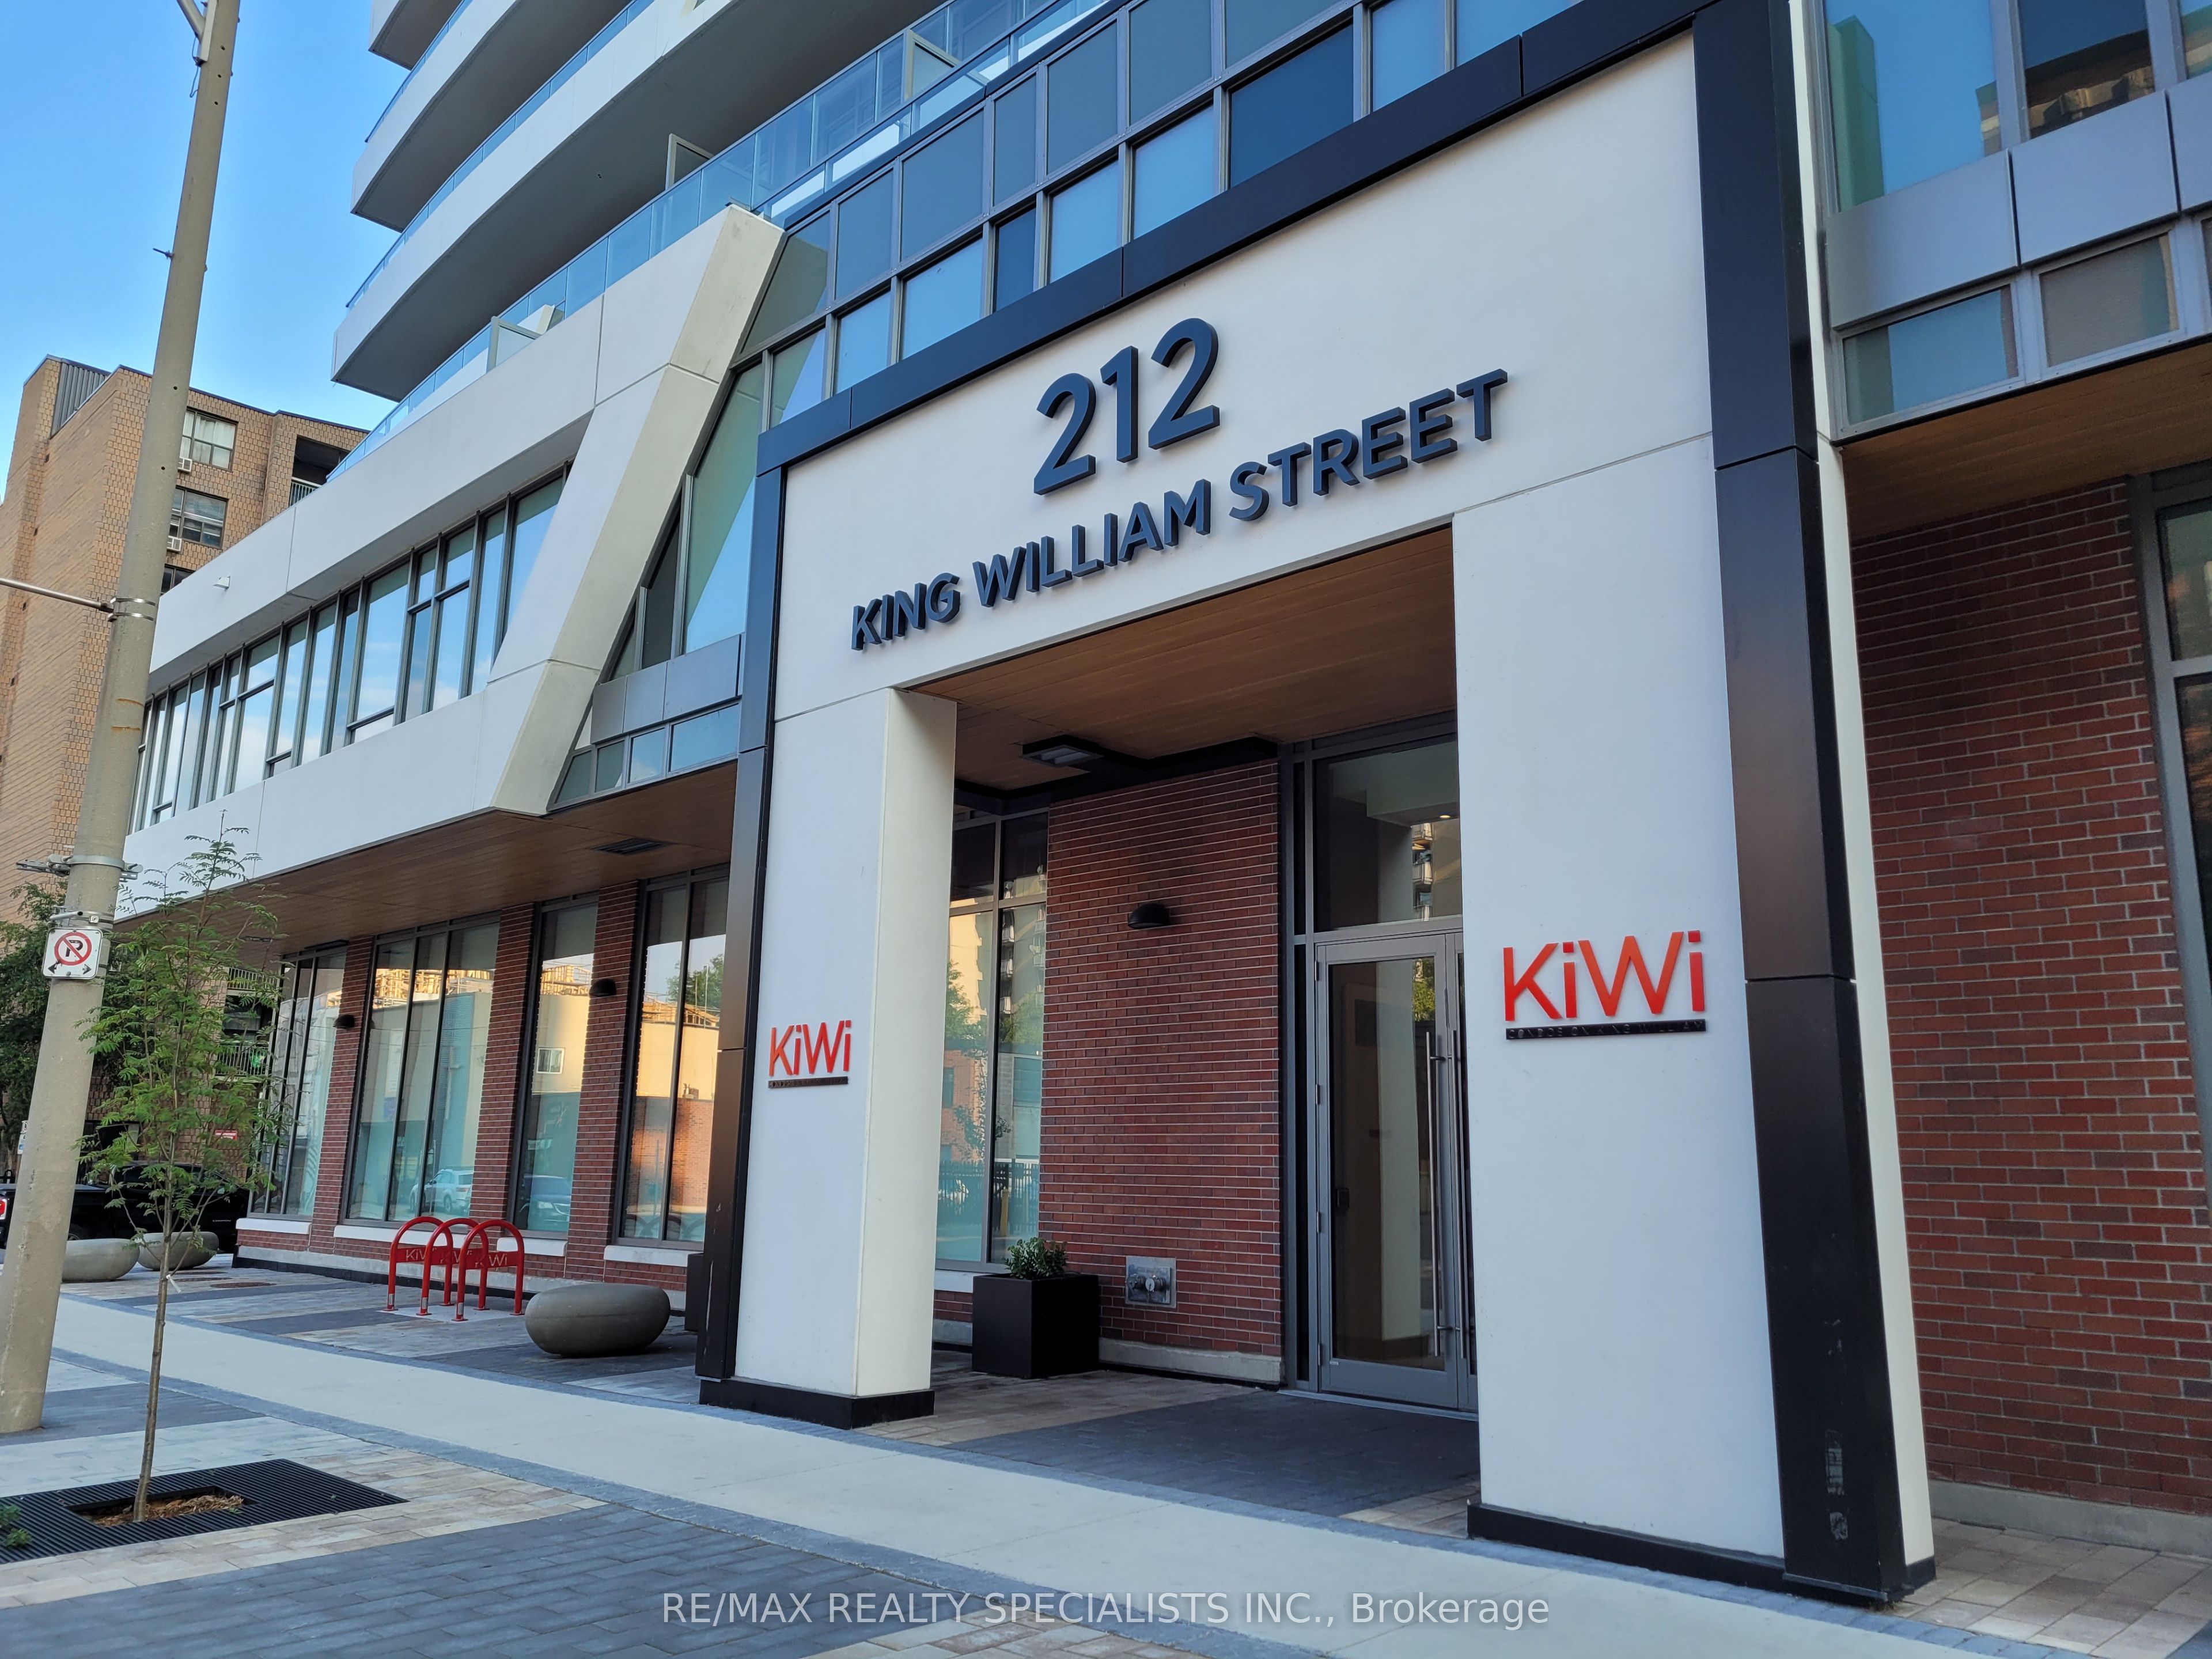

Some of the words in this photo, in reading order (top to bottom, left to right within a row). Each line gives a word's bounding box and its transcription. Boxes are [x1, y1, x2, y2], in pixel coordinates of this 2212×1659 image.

[1033, 317, 1220, 495] 212
[851, 572, 960, 651] KING
[972, 479, 1211, 608] WILLIAM
[1229, 368, 1508, 521] STREET
[1503, 930, 1705, 1021] KiWi
[768, 1019, 851, 1077] KiWi
